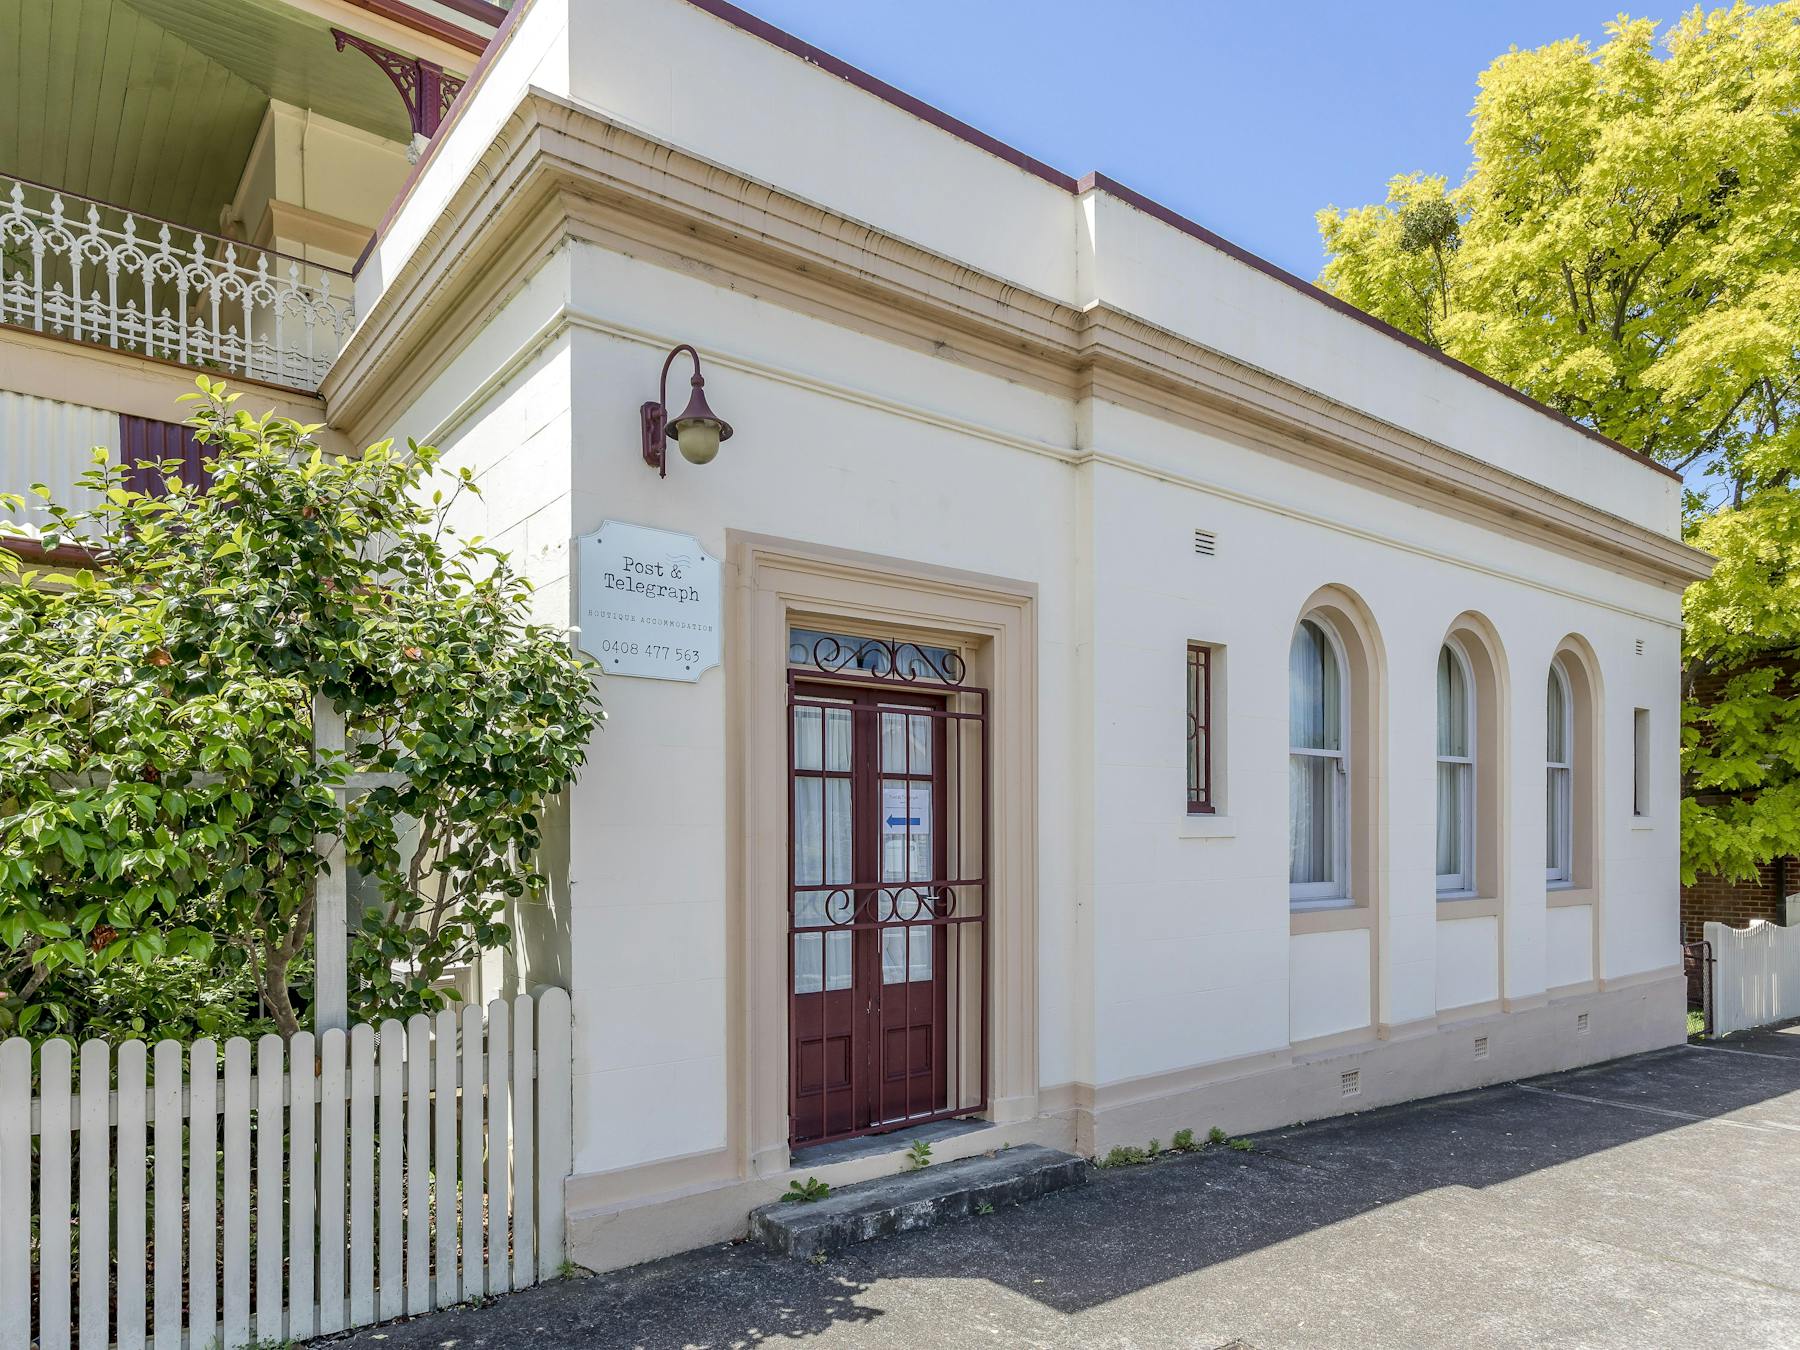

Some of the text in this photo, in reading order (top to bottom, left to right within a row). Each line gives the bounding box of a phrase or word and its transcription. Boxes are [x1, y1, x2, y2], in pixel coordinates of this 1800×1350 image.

[623, 556, 682, 580] Post &
[604, 573, 700, 603] Telegraph
[588, 609, 713, 632] BOUTIQUE ACCOMMODATION
[602, 640, 700, 663] 0408 477 563
